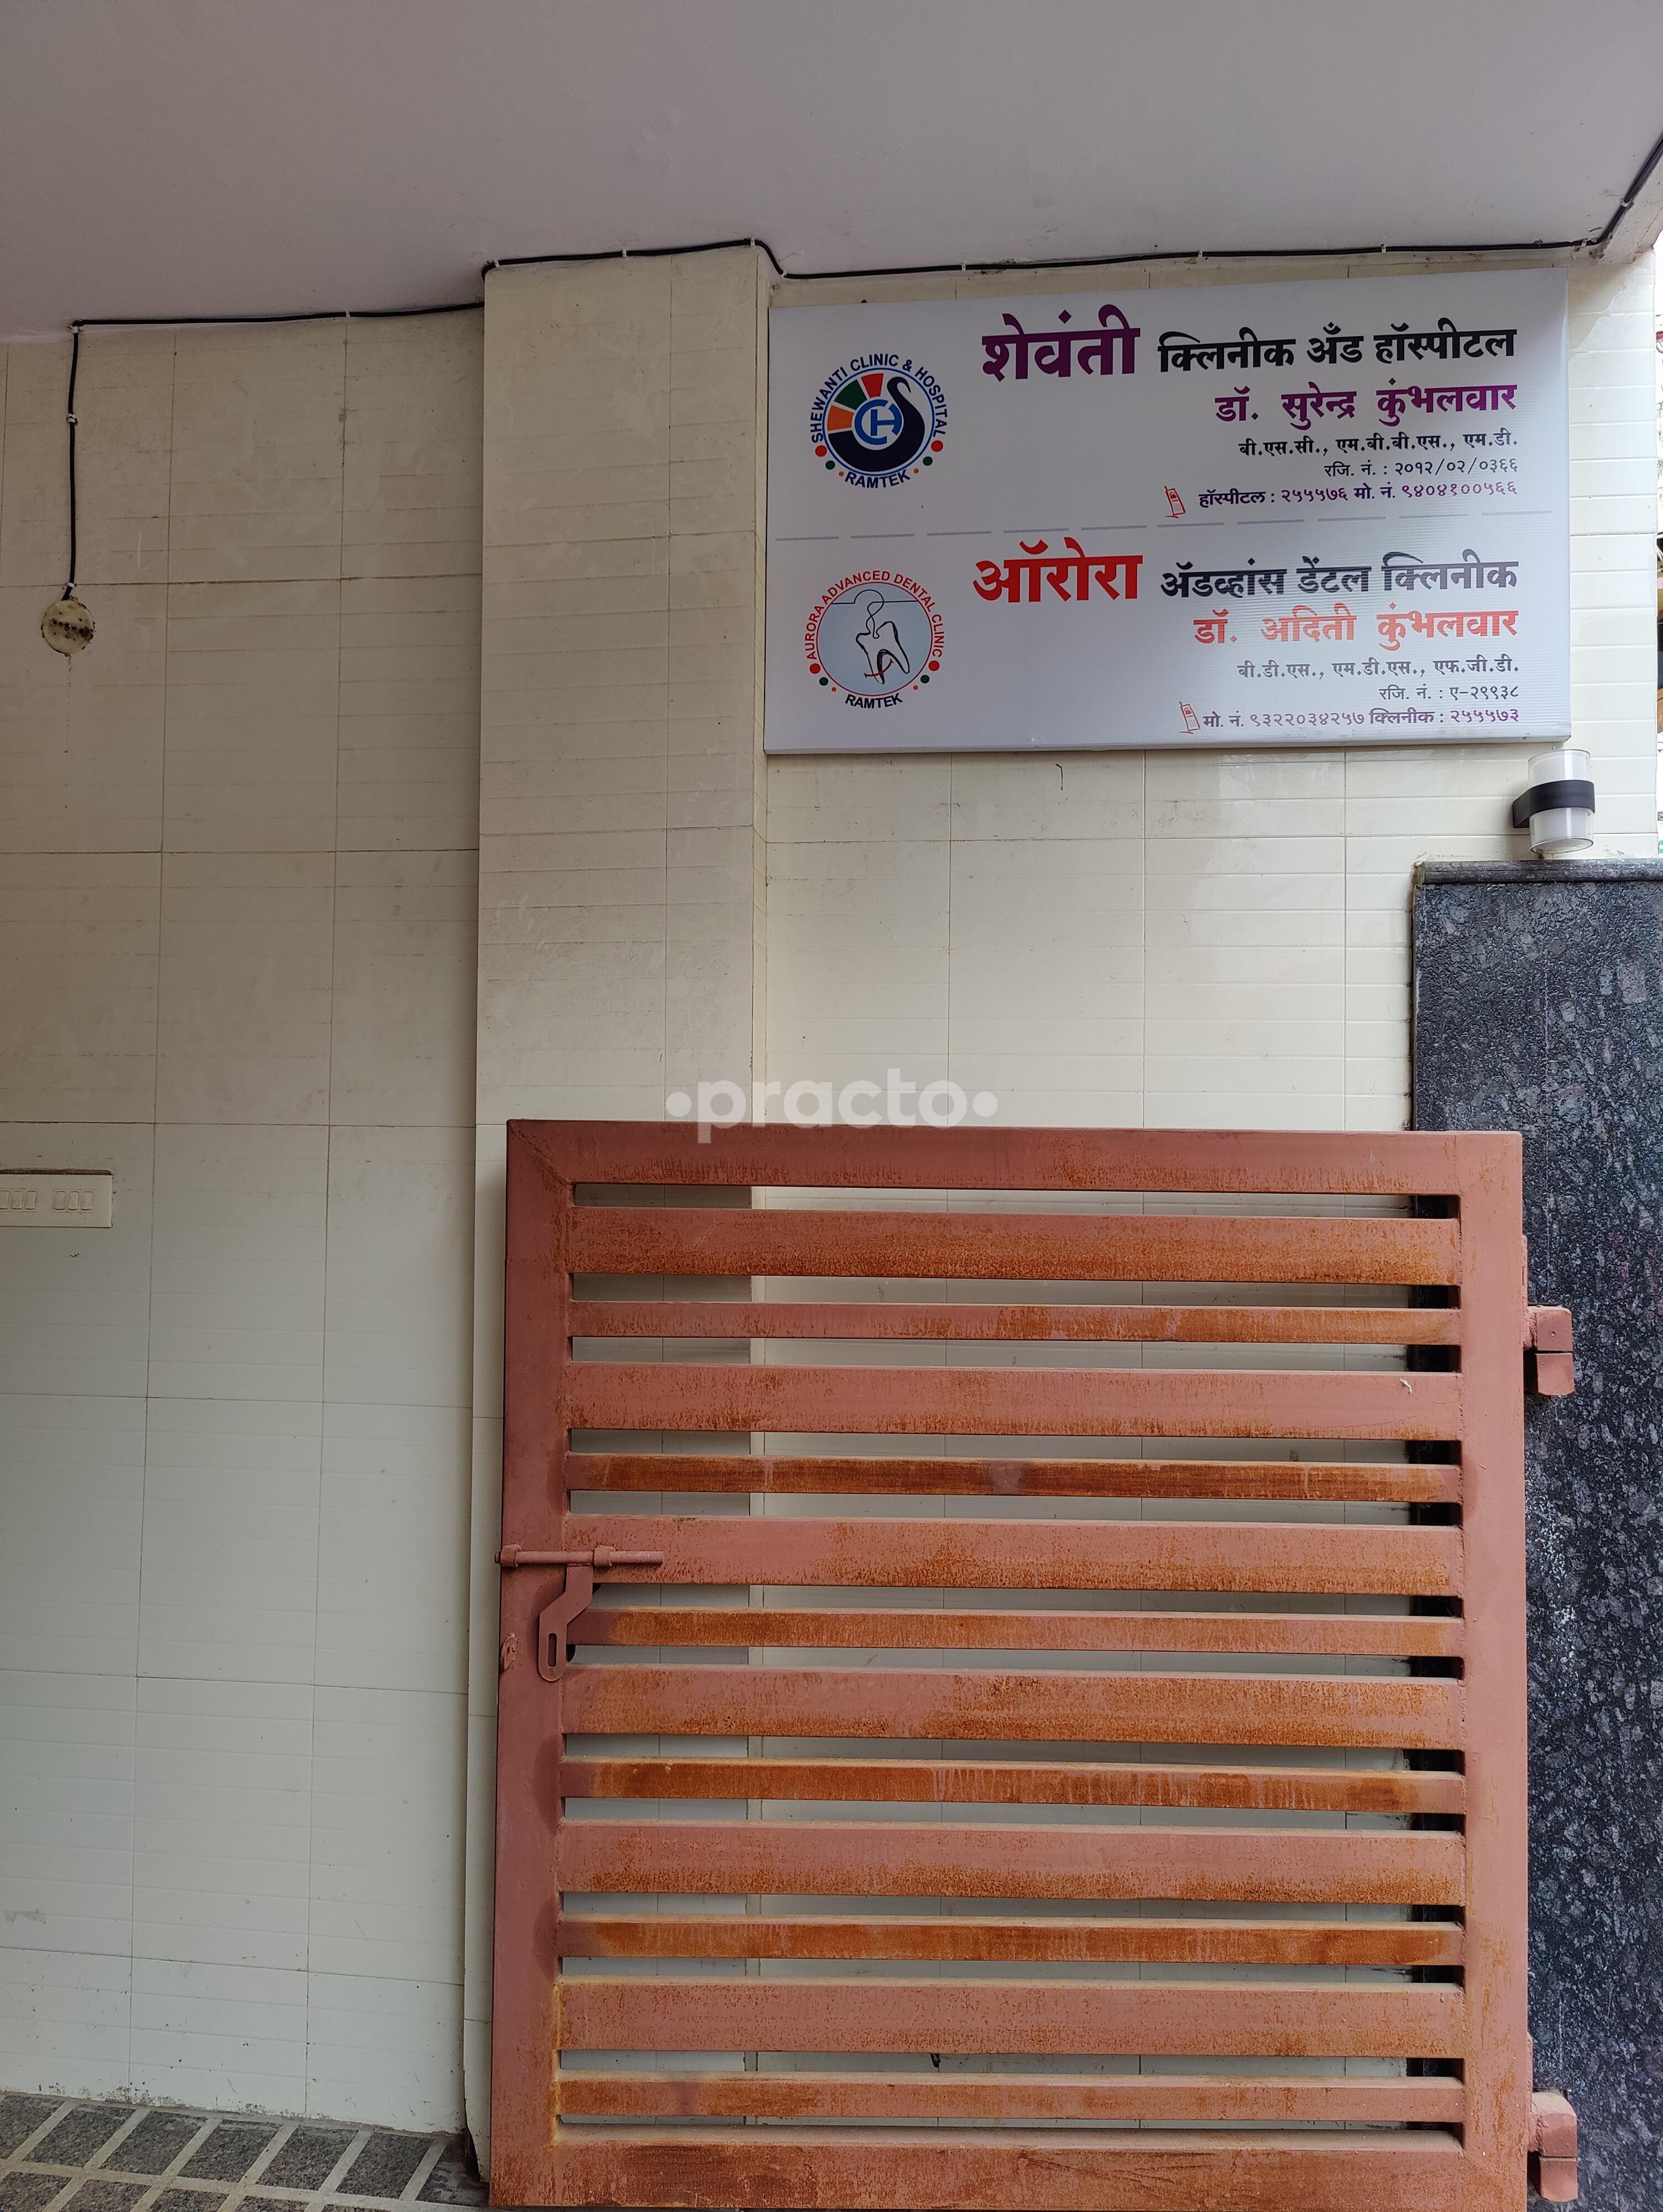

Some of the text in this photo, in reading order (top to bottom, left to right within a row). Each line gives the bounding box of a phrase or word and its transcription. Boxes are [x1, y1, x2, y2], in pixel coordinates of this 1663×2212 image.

[982, 304, 1517, 382] शेवंती क्लिनीक अँड हॉस्पीटल
[810, 353, 948, 443] SHEWANTI CLINIC & HOSPITAL
[1215, 378, 1517, 430] डॉ. सुरेन्द्र कुंभलवार
[1463, 427, 1518, 448] एम.डी.
[845, 469, 911, 488] RAMTEK
[1324, 461, 1354, 477] रजि.
[1395, 457, 1518, 476] २०१२/०२/०३६६
[1199, 488, 1266, 508] हॉस्पीटल
[1282, 488, 1348, 502] २५५५७६
[1354, 483, 1374, 499] मो.
[972, 537, 1143, 603] ऑरोरा
[1296, 556, 1371, 594] डेंटल
[1382, 549, 1518, 591] क्लिनीक
[805, 571, 944, 660] AURORA ADVANCED DENTAL CLINIC
[1193, 602, 1519, 651] डॉ. अदिती कुंभलवार
[1433, 654, 1519, 675] एफ.जी.डी.
[845, 693, 903, 708] RAMTEK
[1379, 684, 1409, 700] रजि.
[1203, 711, 1223, 727] मो.
[1250, 712, 1364, 727] ९३२२०३४२५७
[1369, 707, 1435, 724] क्लिनीक
[1451, 708, 1519, 722] २५५५७३
